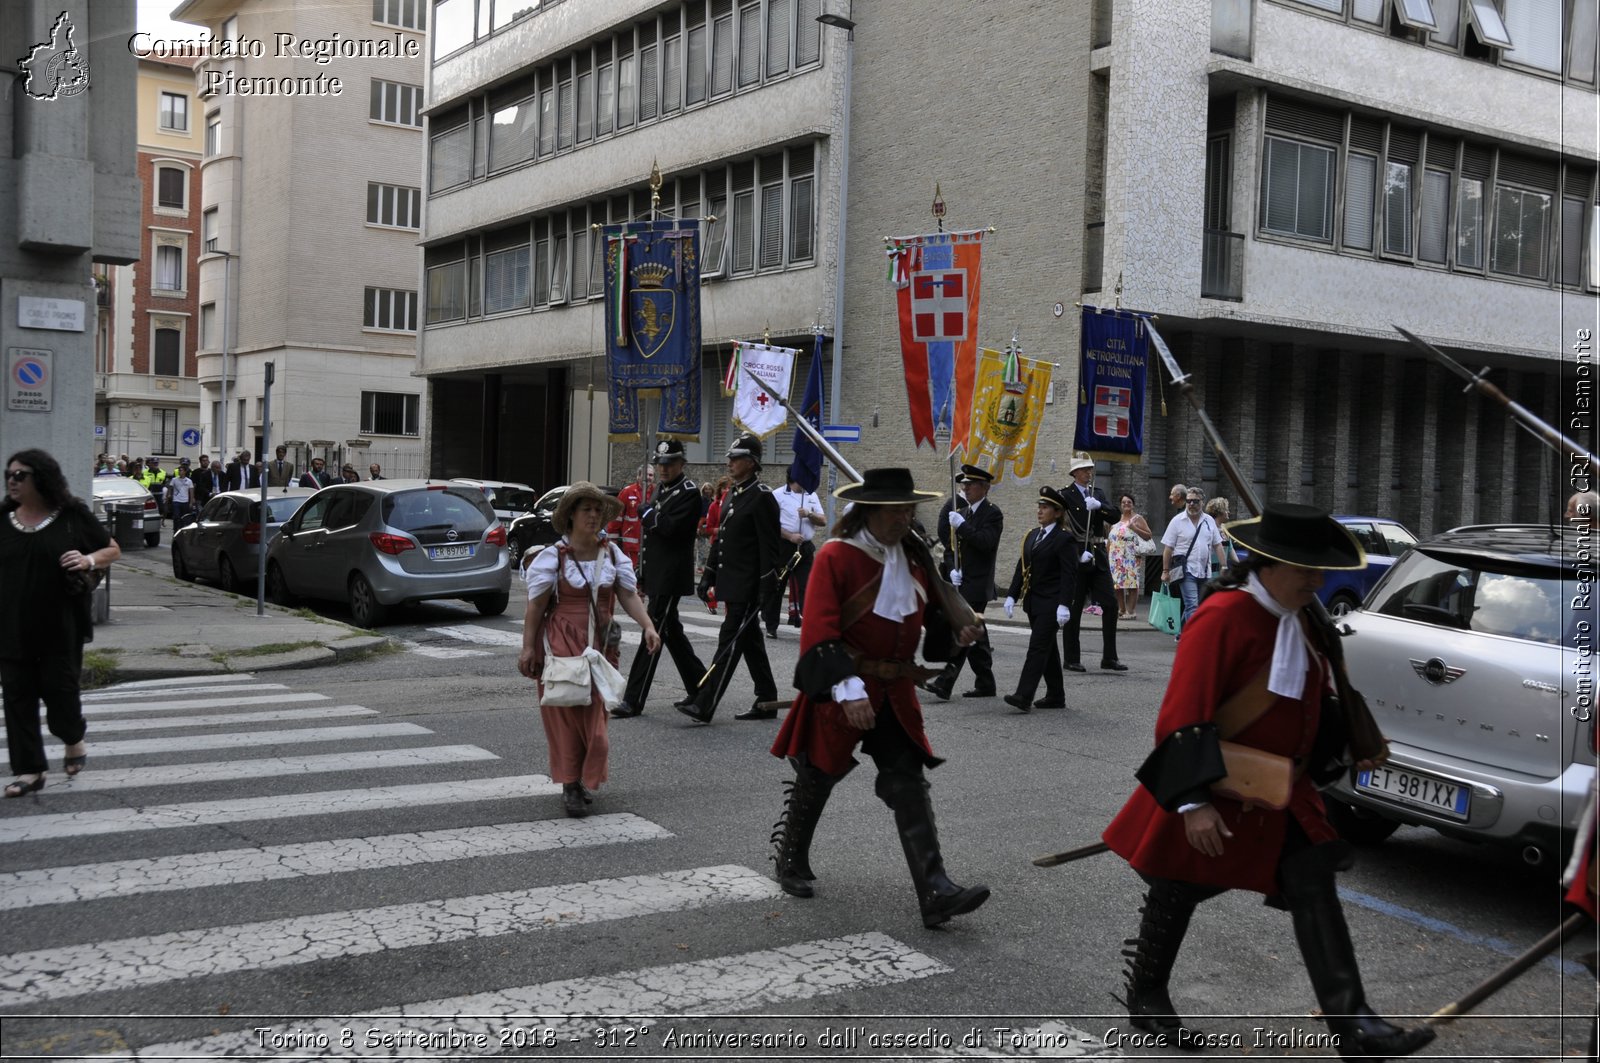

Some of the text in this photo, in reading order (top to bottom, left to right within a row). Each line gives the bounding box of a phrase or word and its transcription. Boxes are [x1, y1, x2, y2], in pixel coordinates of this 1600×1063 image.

[1086, 348, 1145, 367] METROPOLITANA
[743, 361, 765, 370] CROCE
[1096, 364, 1132, 379] DI TORINO
[17, 390, 43, 398] passo
[11, 398, 48, 406] carrabile
[1398, 773, 1455, 808] 981XX
